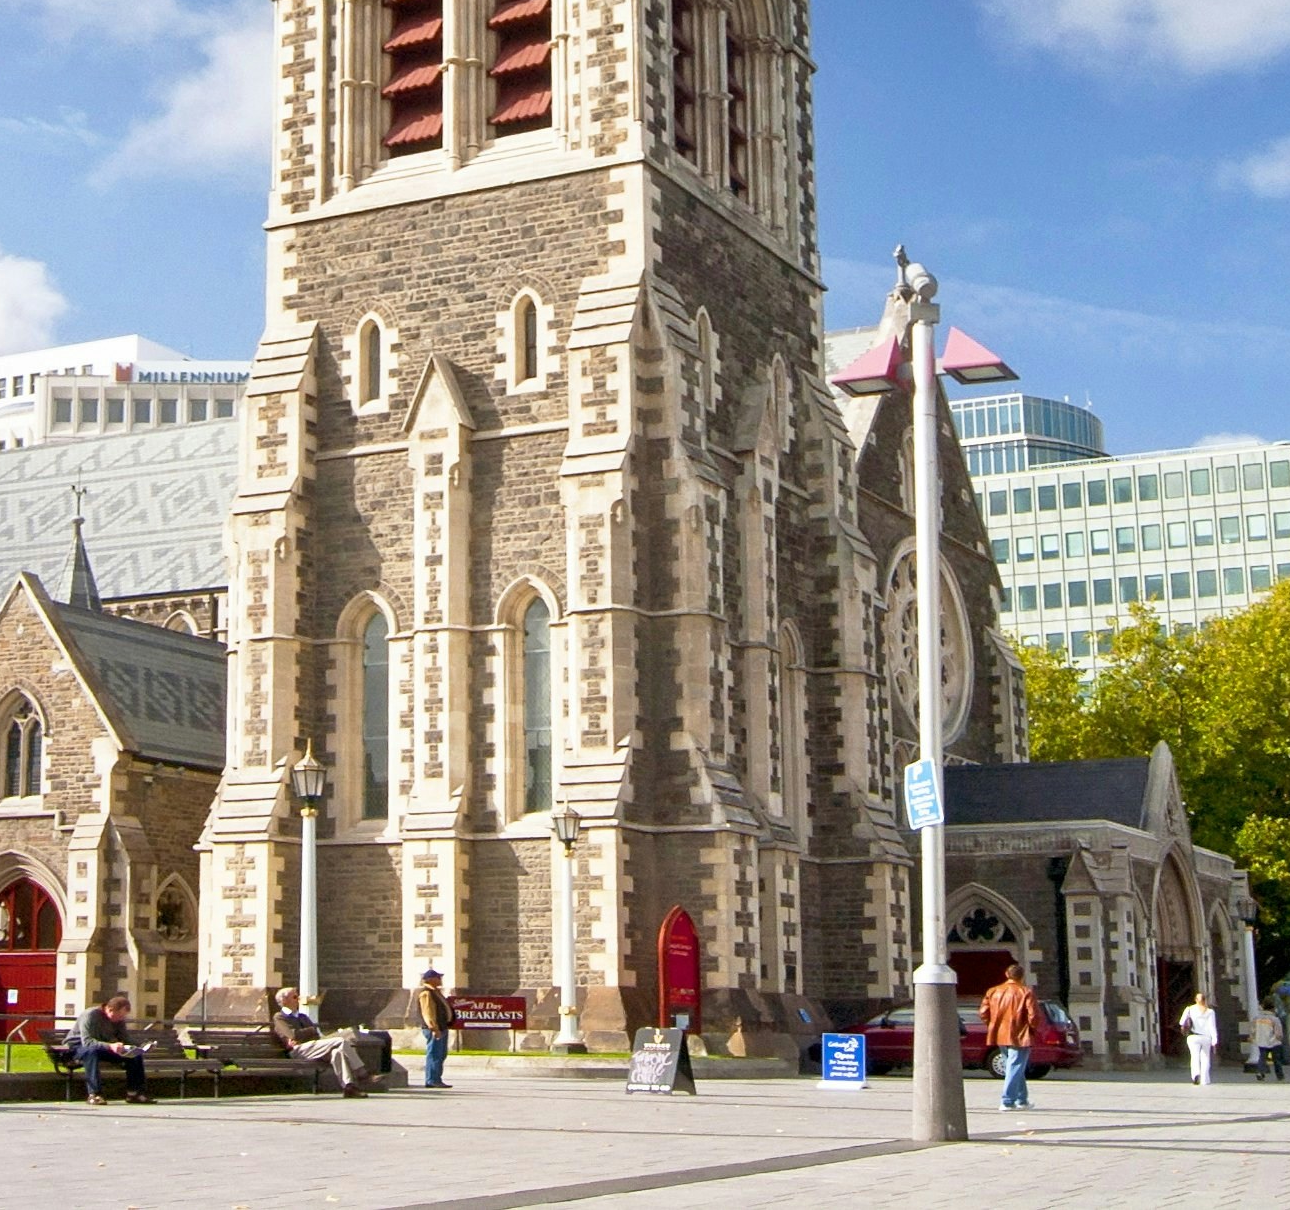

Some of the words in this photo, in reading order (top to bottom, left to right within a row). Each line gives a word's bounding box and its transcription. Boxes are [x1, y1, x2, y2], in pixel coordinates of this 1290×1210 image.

[138, 371, 250, 383] MILLENNIUM
[470, 1002, 485, 1010] All
[486, 1002, 503, 1011] Day
[454, 1010, 524, 1020] BREAKFASTS
[834, 1052, 855, 1060] Open
